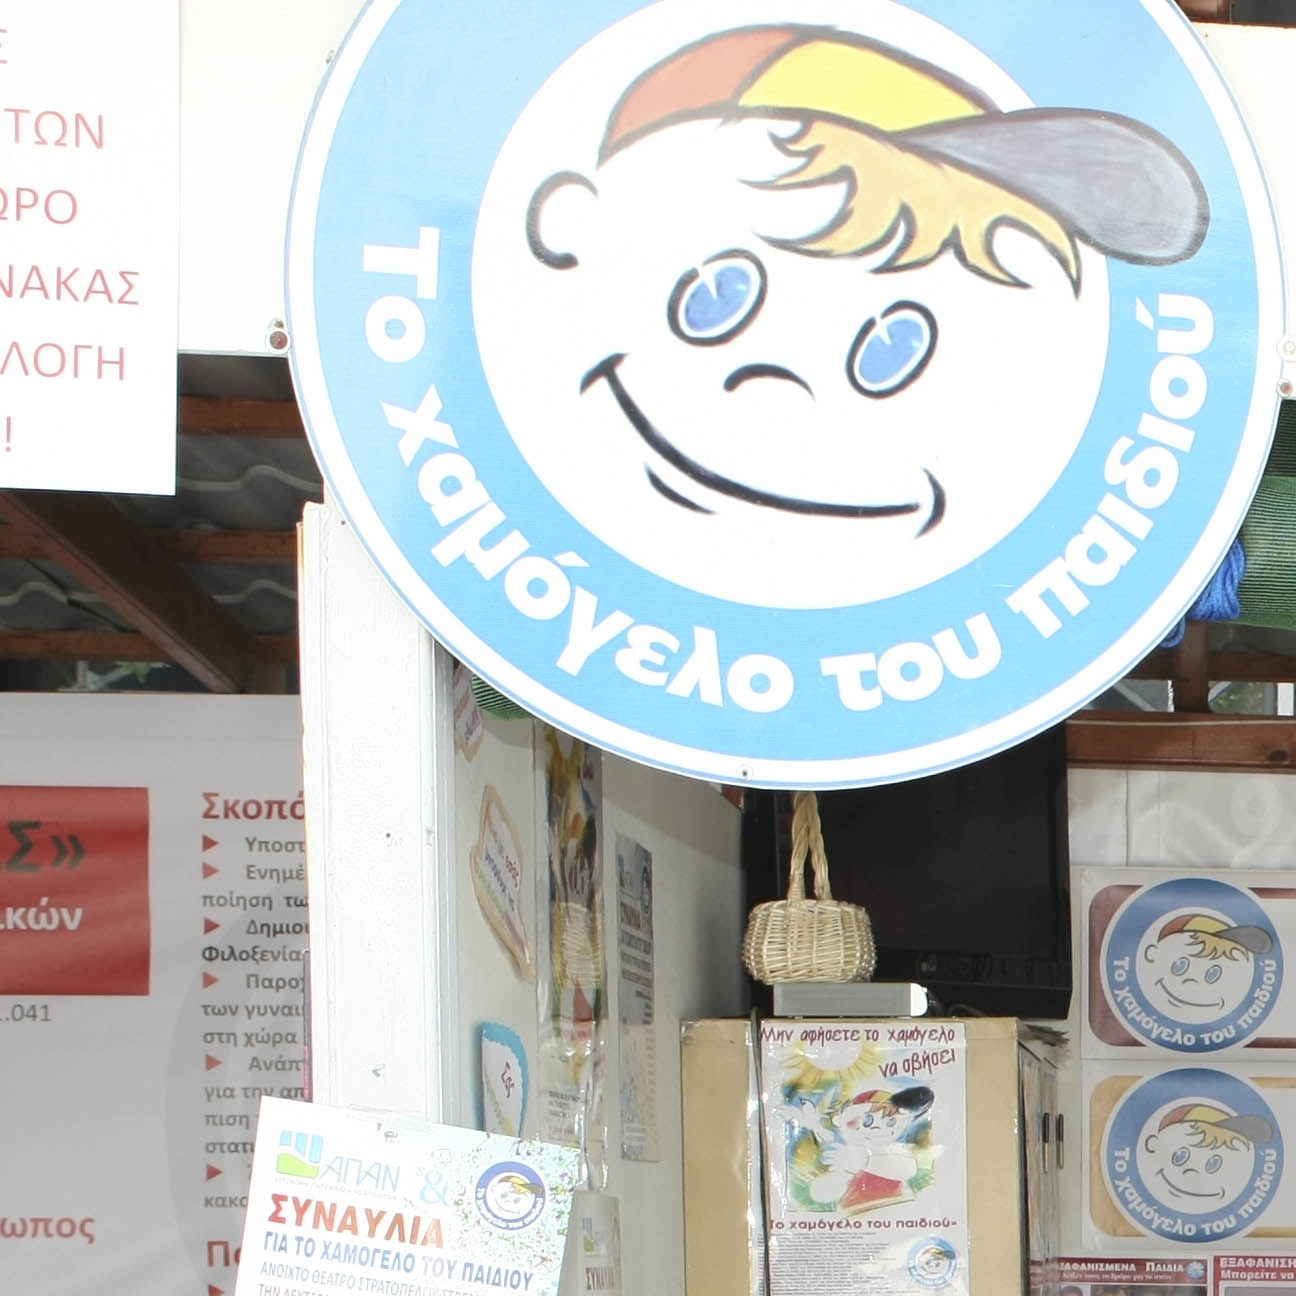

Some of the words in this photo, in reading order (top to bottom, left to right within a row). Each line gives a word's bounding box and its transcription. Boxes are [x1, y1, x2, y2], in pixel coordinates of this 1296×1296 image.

[4, 108, 104, 150] ΤΩΝ
[363, 226, 439, 363] Το
[1007, 293, 1214, 638] παιδιού
[381, 384, 794, 713] χαμόγελο
[820, 613, 1002, 711] του
[202, 892, 272, 911] ποίηση
[1113, 957, 1129, 984] Το
[1237, 959, 1276, 1034] παιδιού
[202, 1004, 238, 1017] των
[1116, 986, 1196, 1047] χαμόγελο
[203, 1031, 237, 1048] στη
[244, 1027, 296, 1047] χώρα
[800, 1026, 860, 1047] αφήσετε
[865, 1028, 879, 1041] το
[888, 1026, 955, 1046] χαμόγελο
[1200, 1024, 1236, 1045] του
[880, 1063, 898, 1078] να
[205, 1084, 235, 1102] για
[268, 1193, 444, 1249] ΣΥΝΑΥΛΙΑ
[790, 1219, 862, 1232] χαμόγελο
[868, 1220, 890, 1229] του
[264, 1231, 288, 1254] ΓΙΑ
[295, 1236, 316, 1258] ΤΟ
[320, 1240, 416, 1273] ΧΑΜΟΓΕΛΟ
[422, 1255, 457, 1280] ΤΟΥ
[462, 1262, 534, 1291] ΠΑΙΔΙΟΥ
[260, 1261, 309, 1282] ΑΝΟΙΧΤΟ
[312, 1270, 355, 1289] ΘΕΑΤΡΟ
[1220, 1269, 1276, 1281] Μπορείτε
[1280, 1271, 1294, 1280] να
